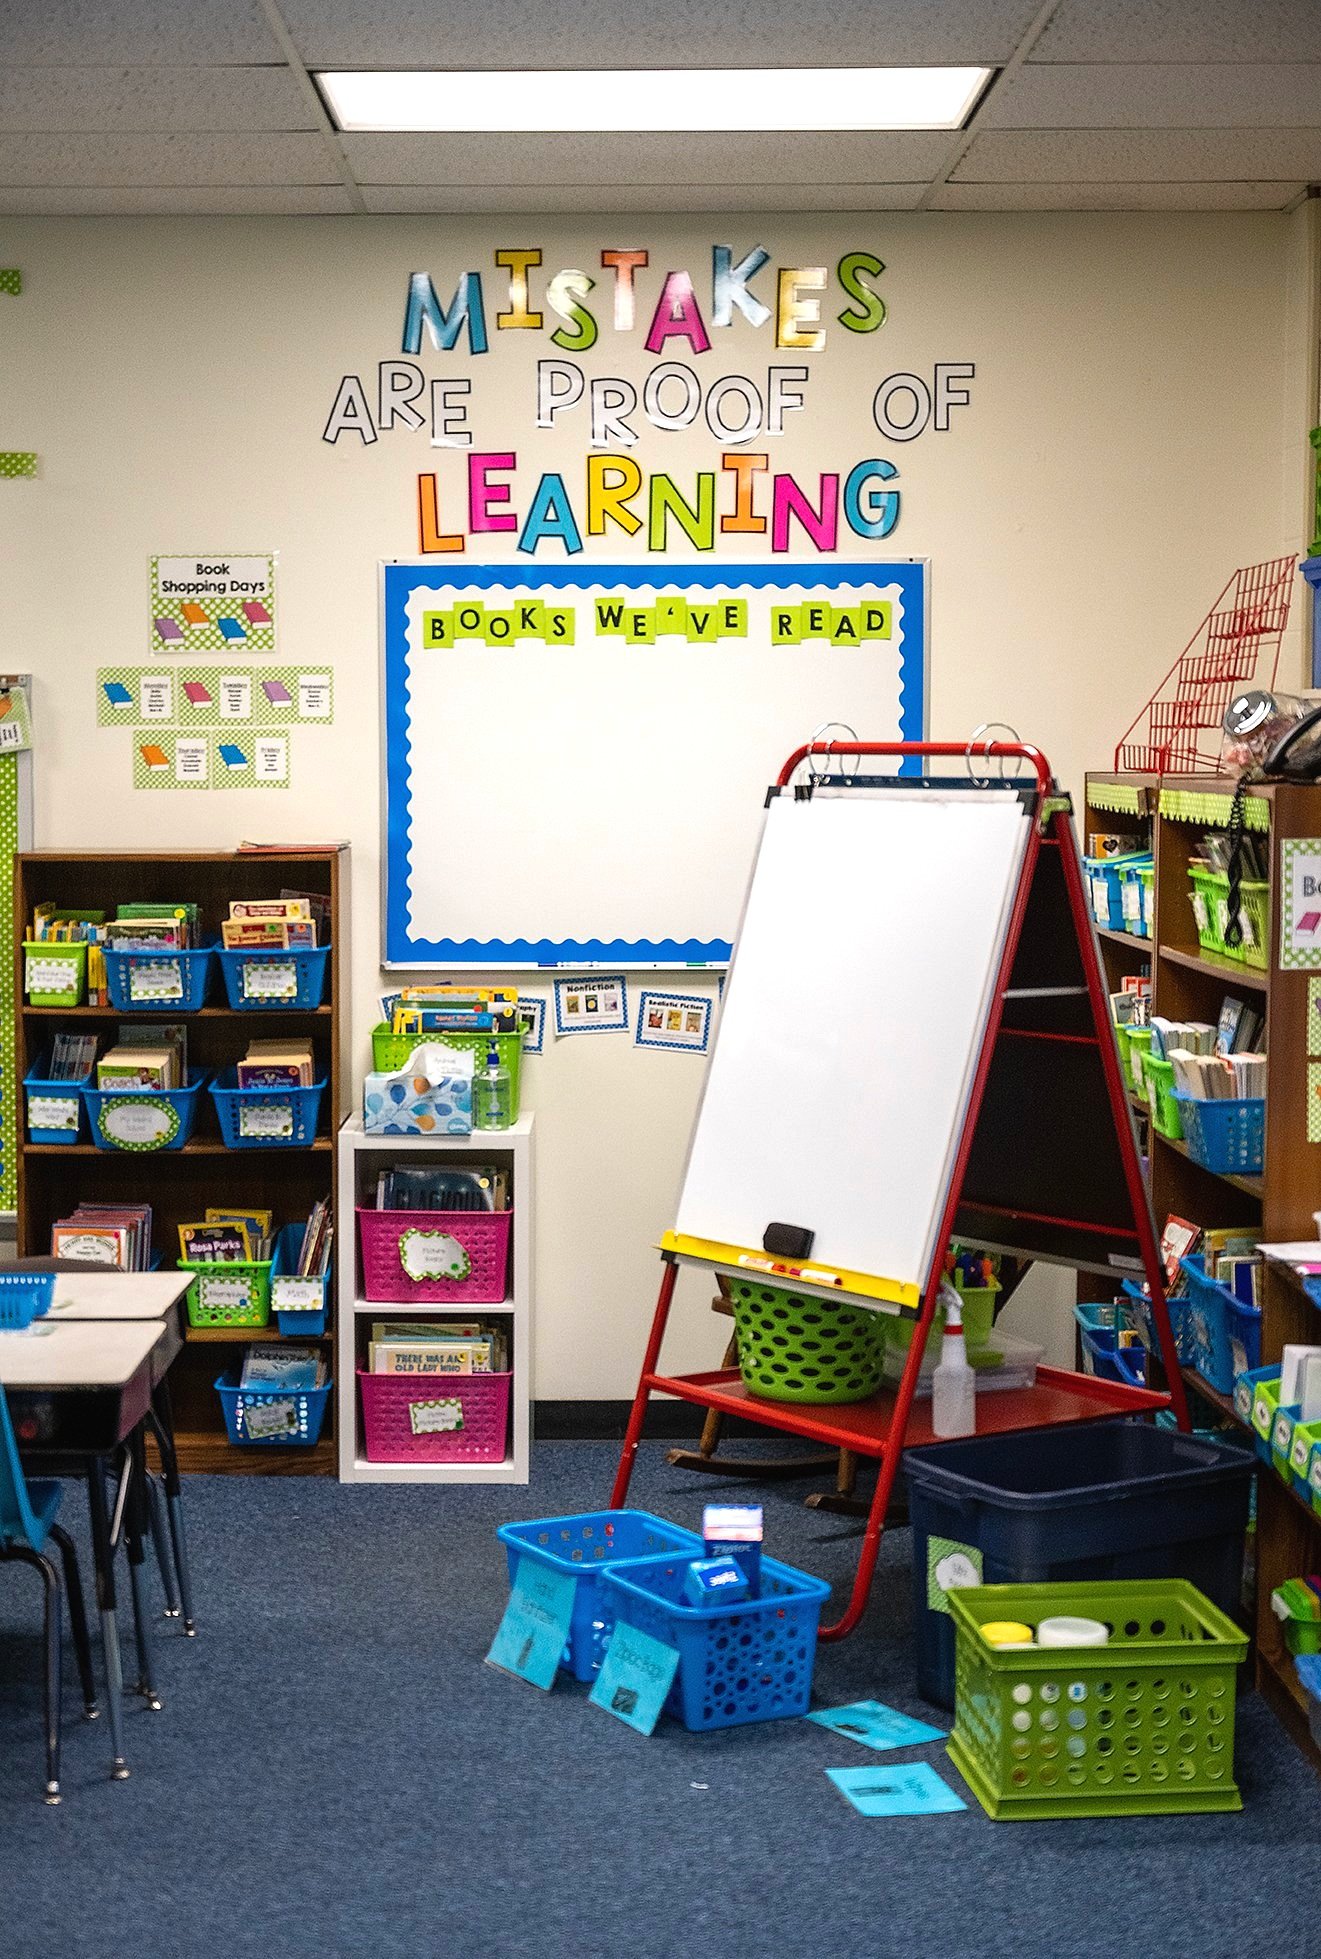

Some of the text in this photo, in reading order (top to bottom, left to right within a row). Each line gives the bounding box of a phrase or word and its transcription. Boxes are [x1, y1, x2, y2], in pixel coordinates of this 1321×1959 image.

[401, 245, 887, 354] MISTAKES
[323, 361, 974, 448] ARE PROOF OF
[418, 452, 901, 555] LEARNING
[196, 563, 230, 576] Book
[162, 580, 266, 594] Shopping Days
[431, 606, 567, 641] BOOKS
[778, 609, 886, 639] READ
[567, 983, 615, 993] Nonfiction
[648, 999, 704, 1011] Realistic Fiction
[189, 1239, 241, 1253] Rosa Parks
[395, 1354, 422, 1364] THERE
[426, 1354, 444, 1363] WAS
[395, 1363, 461, 1372] OLD LADY WHO
